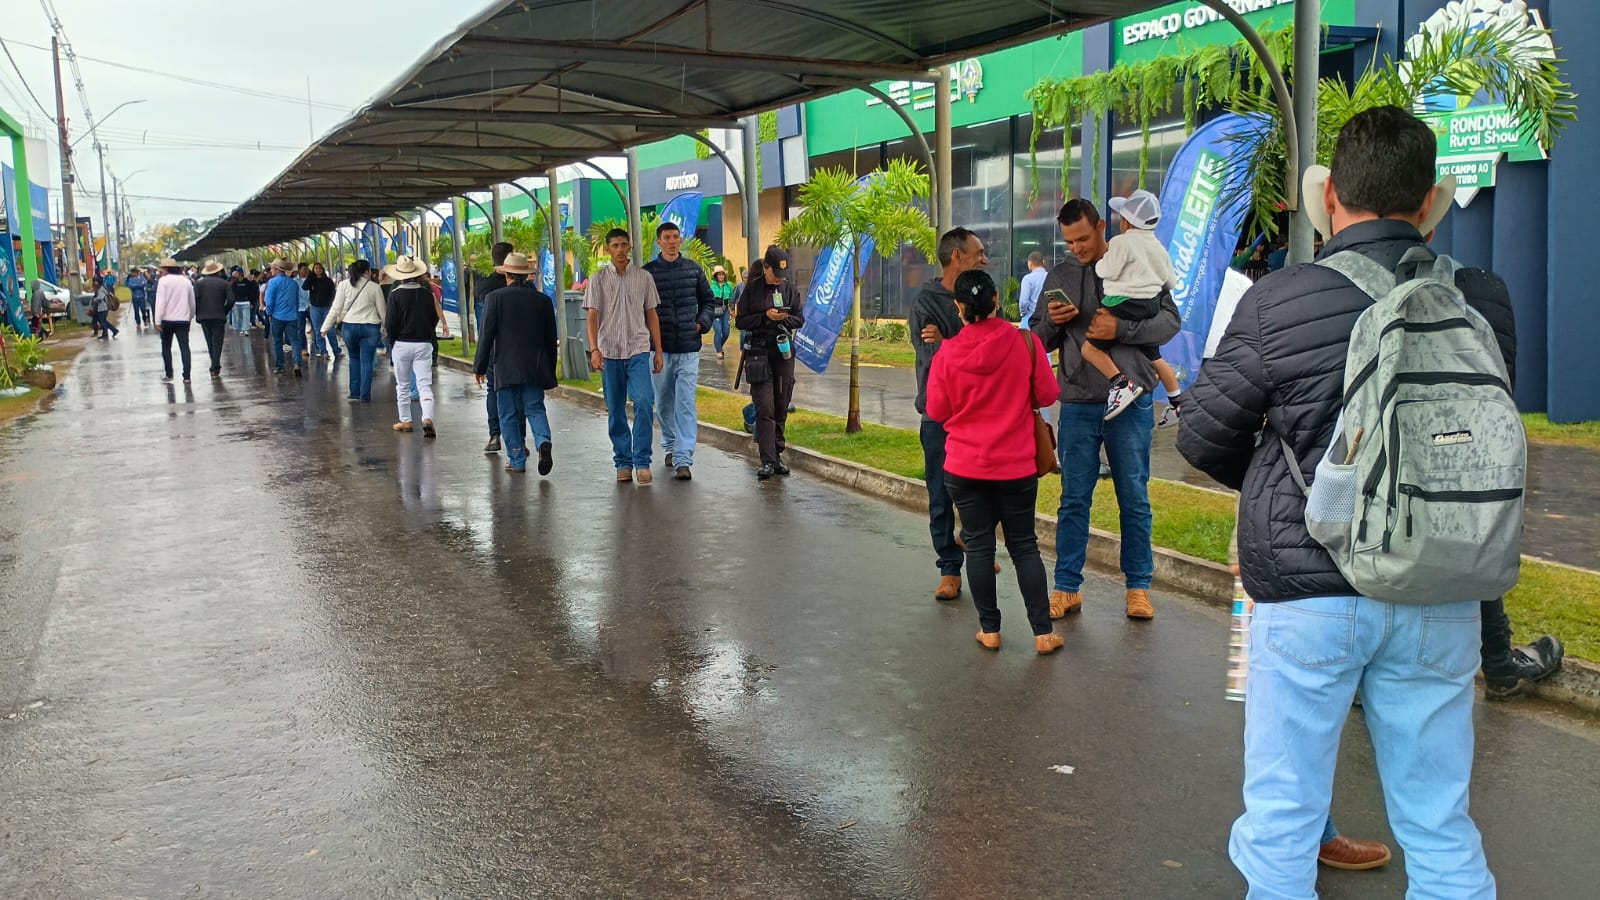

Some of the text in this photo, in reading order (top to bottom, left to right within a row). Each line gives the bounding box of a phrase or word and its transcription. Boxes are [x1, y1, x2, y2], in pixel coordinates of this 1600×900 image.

[1123, 13, 1181, 45] ESPAÇO
[1450, 112, 1519, 133] RONDÔNIA
[1450, 130, 1519, 148] Rural Show
[1440, 163, 1488, 175] DO CAMPO AO
[1456, 174, 1478, 185] TURO
